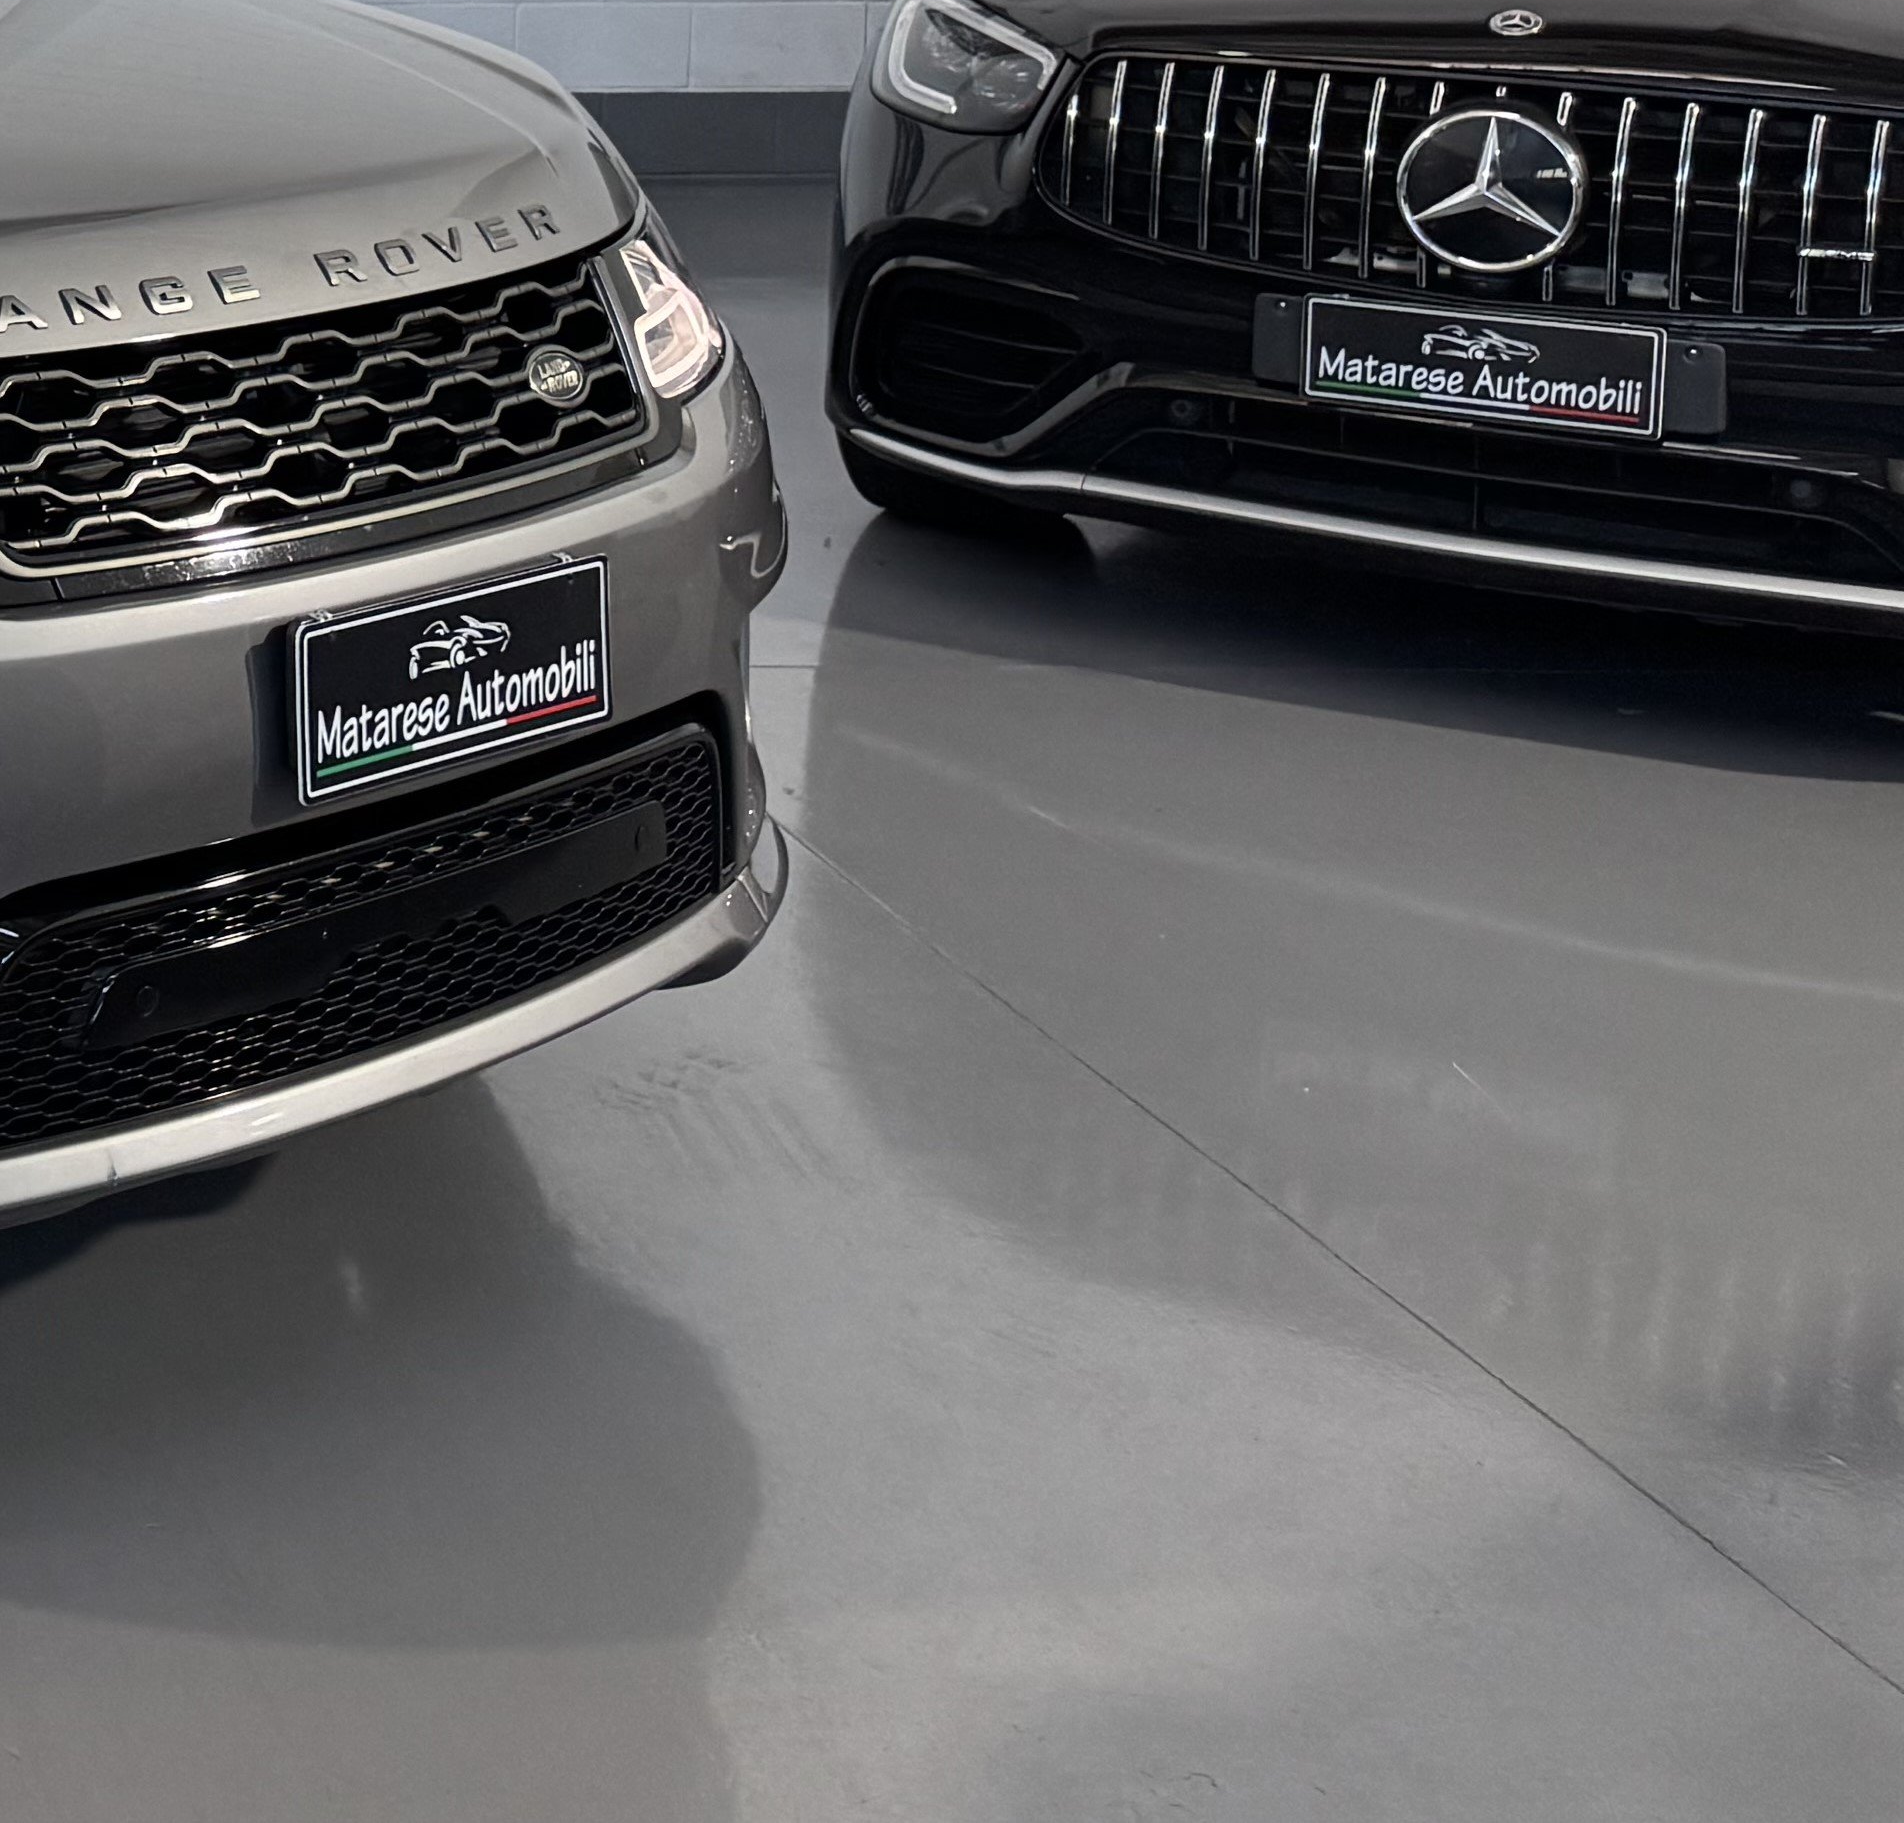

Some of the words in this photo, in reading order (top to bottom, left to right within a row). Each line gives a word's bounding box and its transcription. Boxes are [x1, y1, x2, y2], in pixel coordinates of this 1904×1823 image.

[313, 203, 561, 287] ROVER
[1318, 346, 1464, 395] Matarese
[1472, 364, 1642, 415] Automobili
[318, 692, 451, 763] Matarese
[456, 640, 596, 726] Automobili
